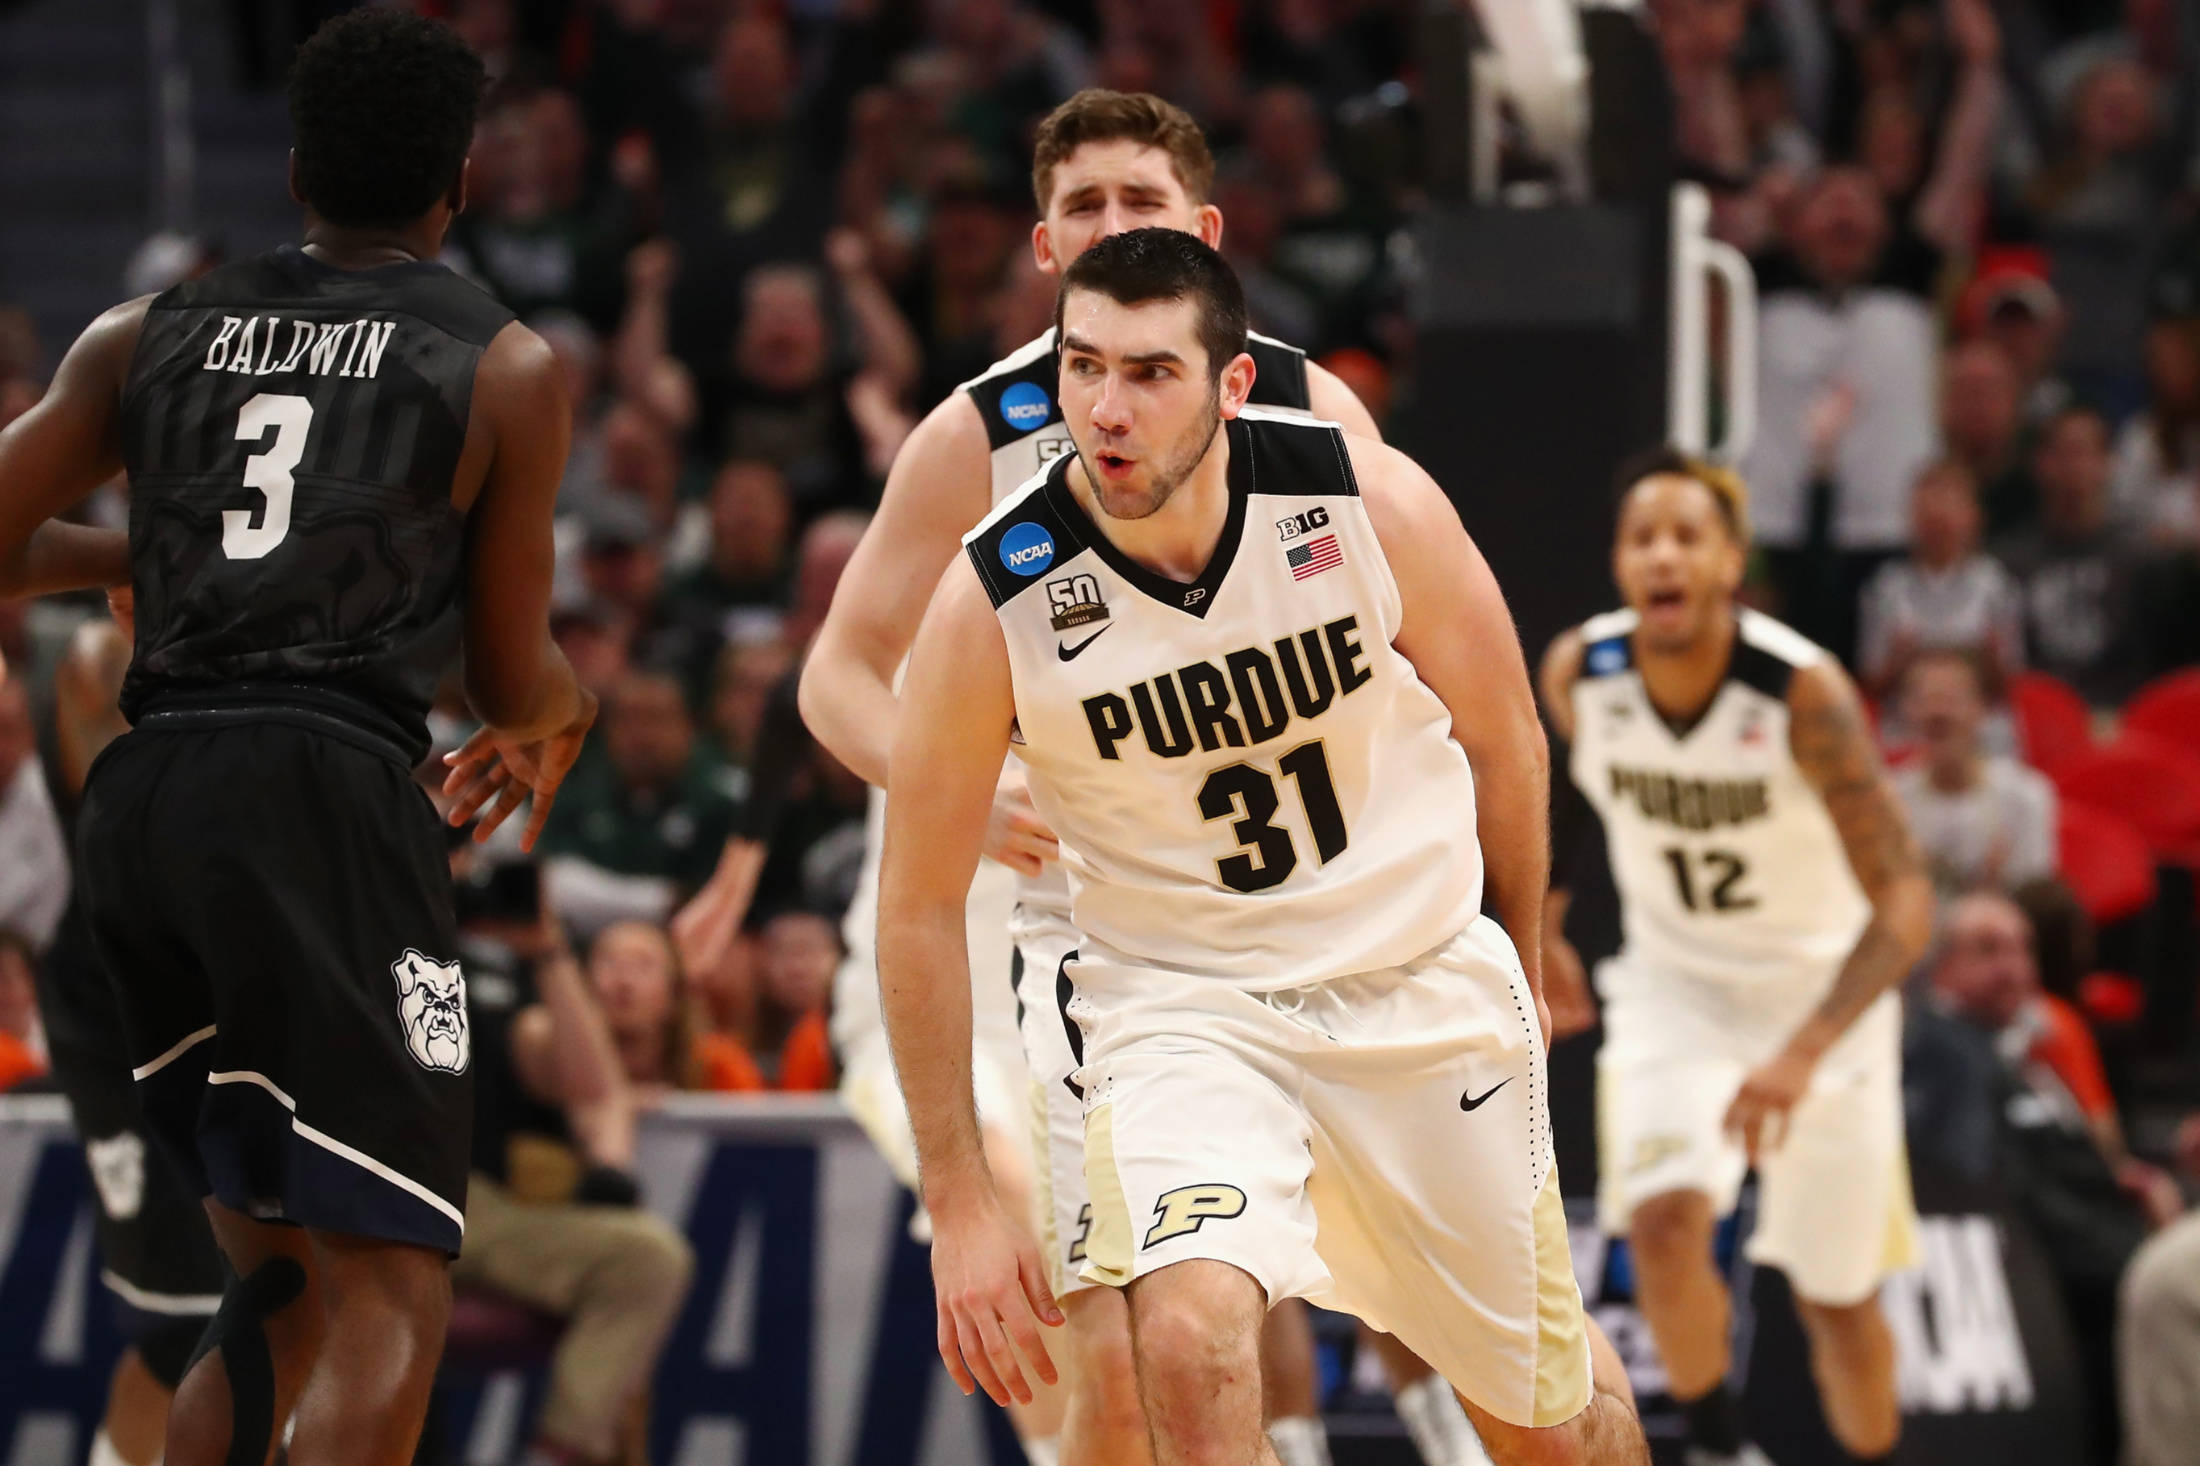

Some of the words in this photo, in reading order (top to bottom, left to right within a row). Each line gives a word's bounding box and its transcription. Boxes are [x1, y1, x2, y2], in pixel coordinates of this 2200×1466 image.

[203, 316, 396, 379] BALDWIN
[1007, 403, 1048, 419] NCAA
[221, 393, 314, 559] 3
[1008, 541, 1053, 567] NCAA
[1046, 573, 1102, 617] 50
[1184, 588, 1206, 606] P
[1080, 612, 1375, 761] PURDUE
[1194, 737, 1348, 893] 31
[1664, 847, 1758, 914] 12
[1142, 1183, 1247, 1251] P
